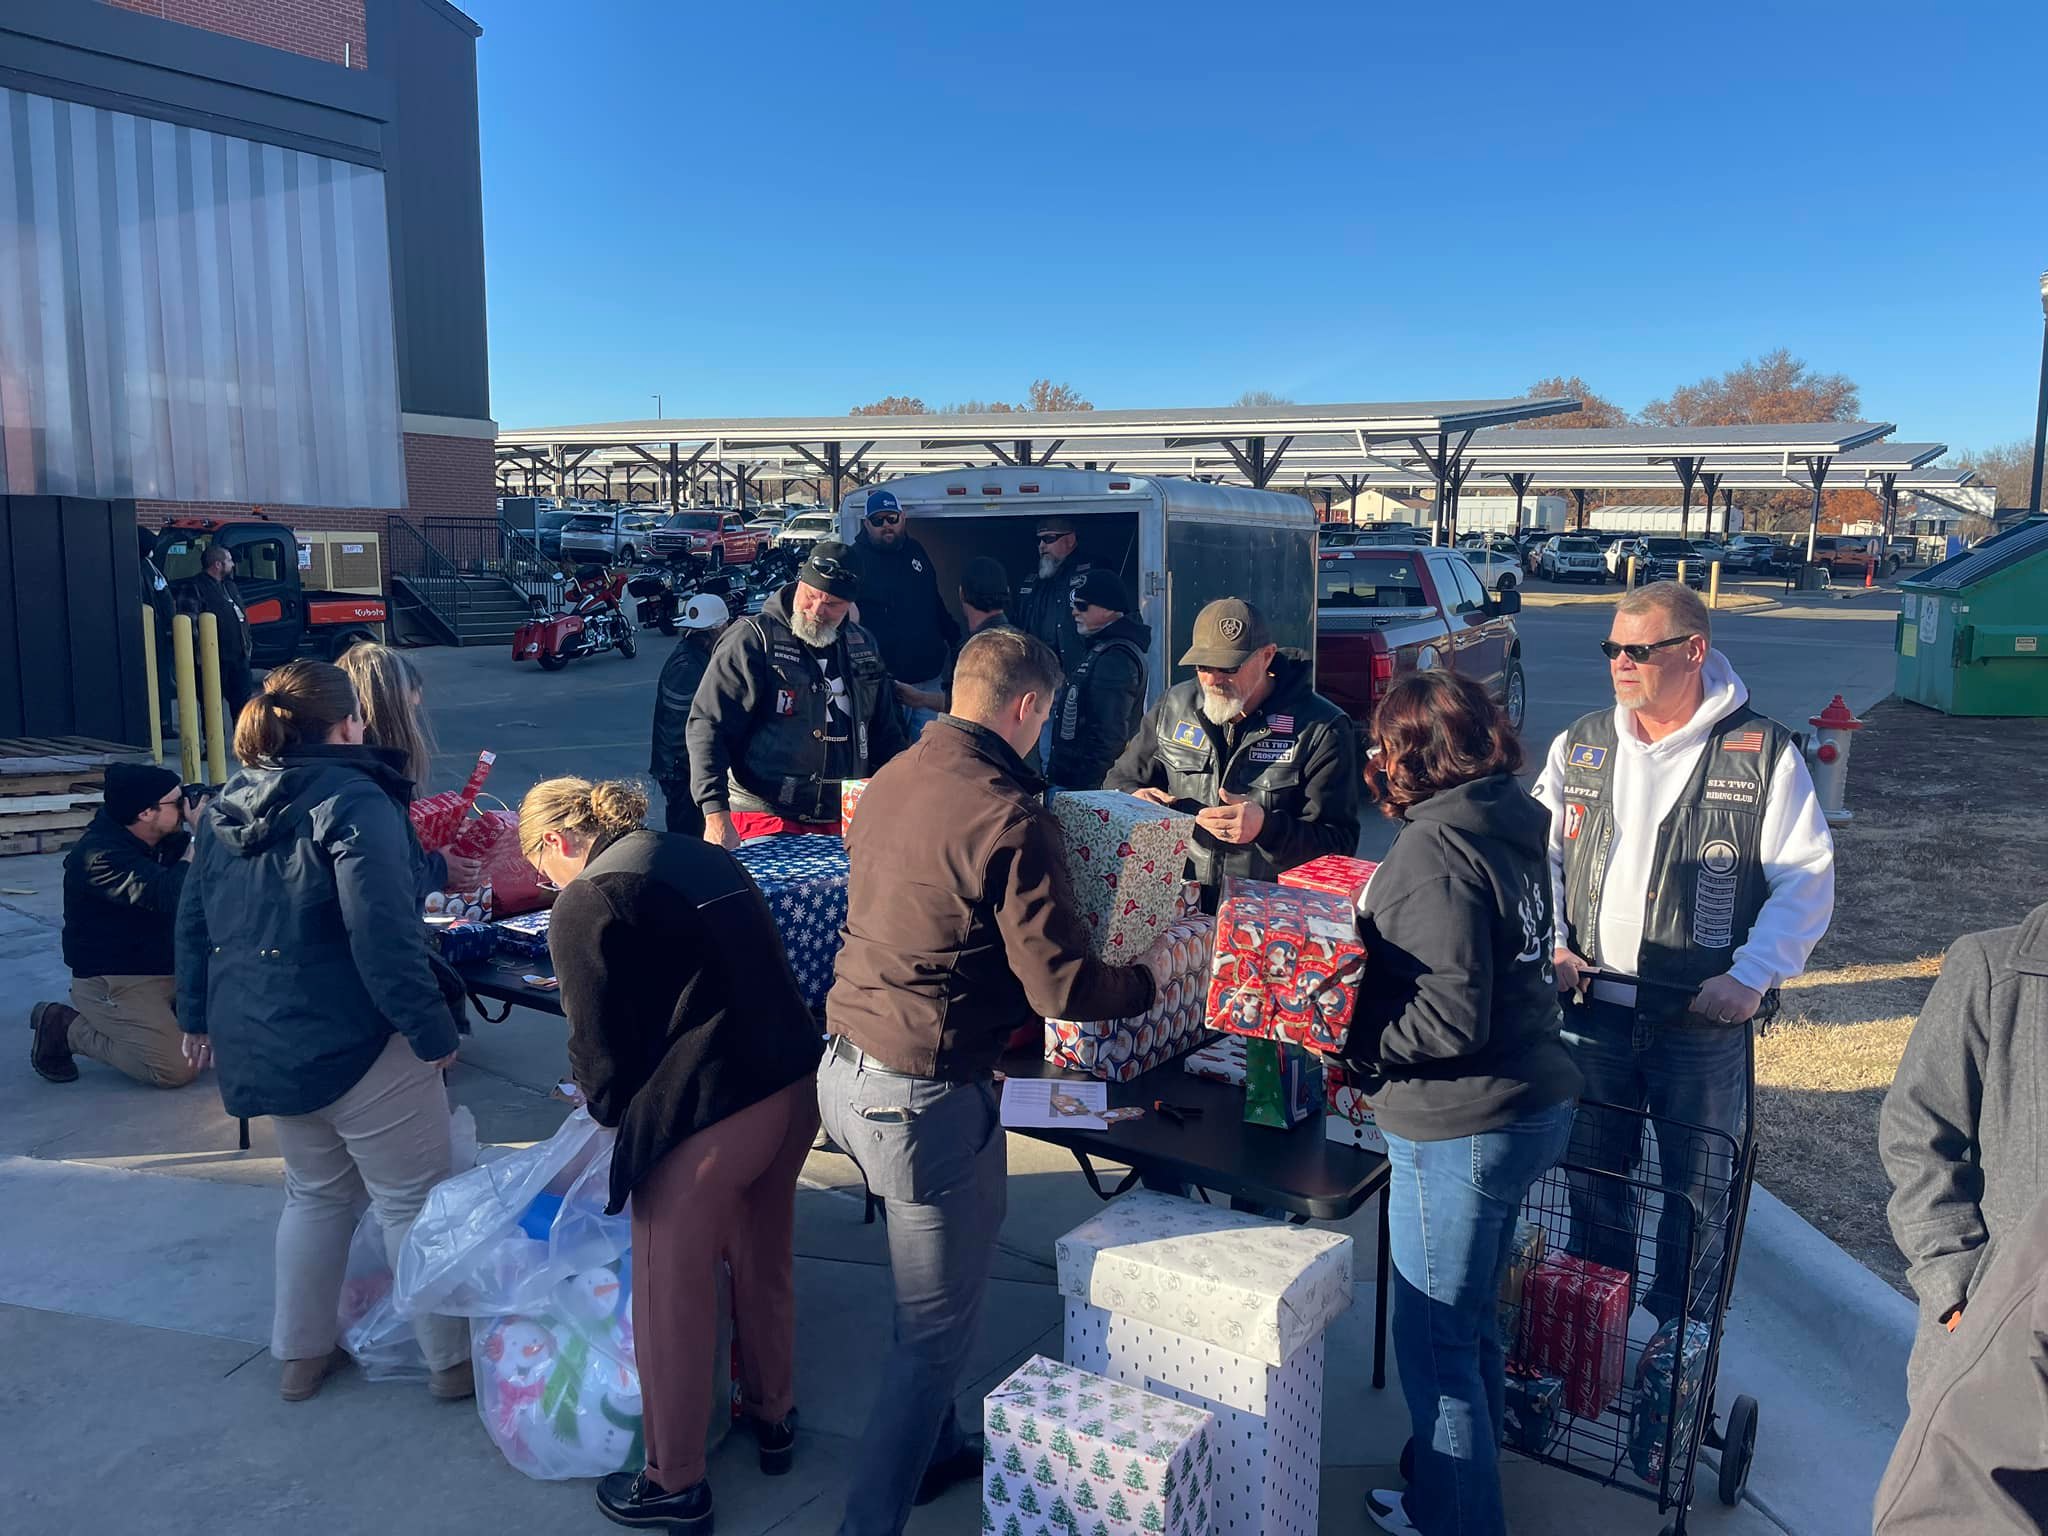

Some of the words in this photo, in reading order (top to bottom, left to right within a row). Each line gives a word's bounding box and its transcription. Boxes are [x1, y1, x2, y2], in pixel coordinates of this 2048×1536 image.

[355, 608, 384, 616] Kubota
[1252, 751, 1290, 760] PROSPECT
[1707, 779, 1726, 788] SIX
[1727, 780, 1756, 790] TWO
[1705, 791, 1732, 800] RIDING
[1733, 794, 1753, 803] CLUB
